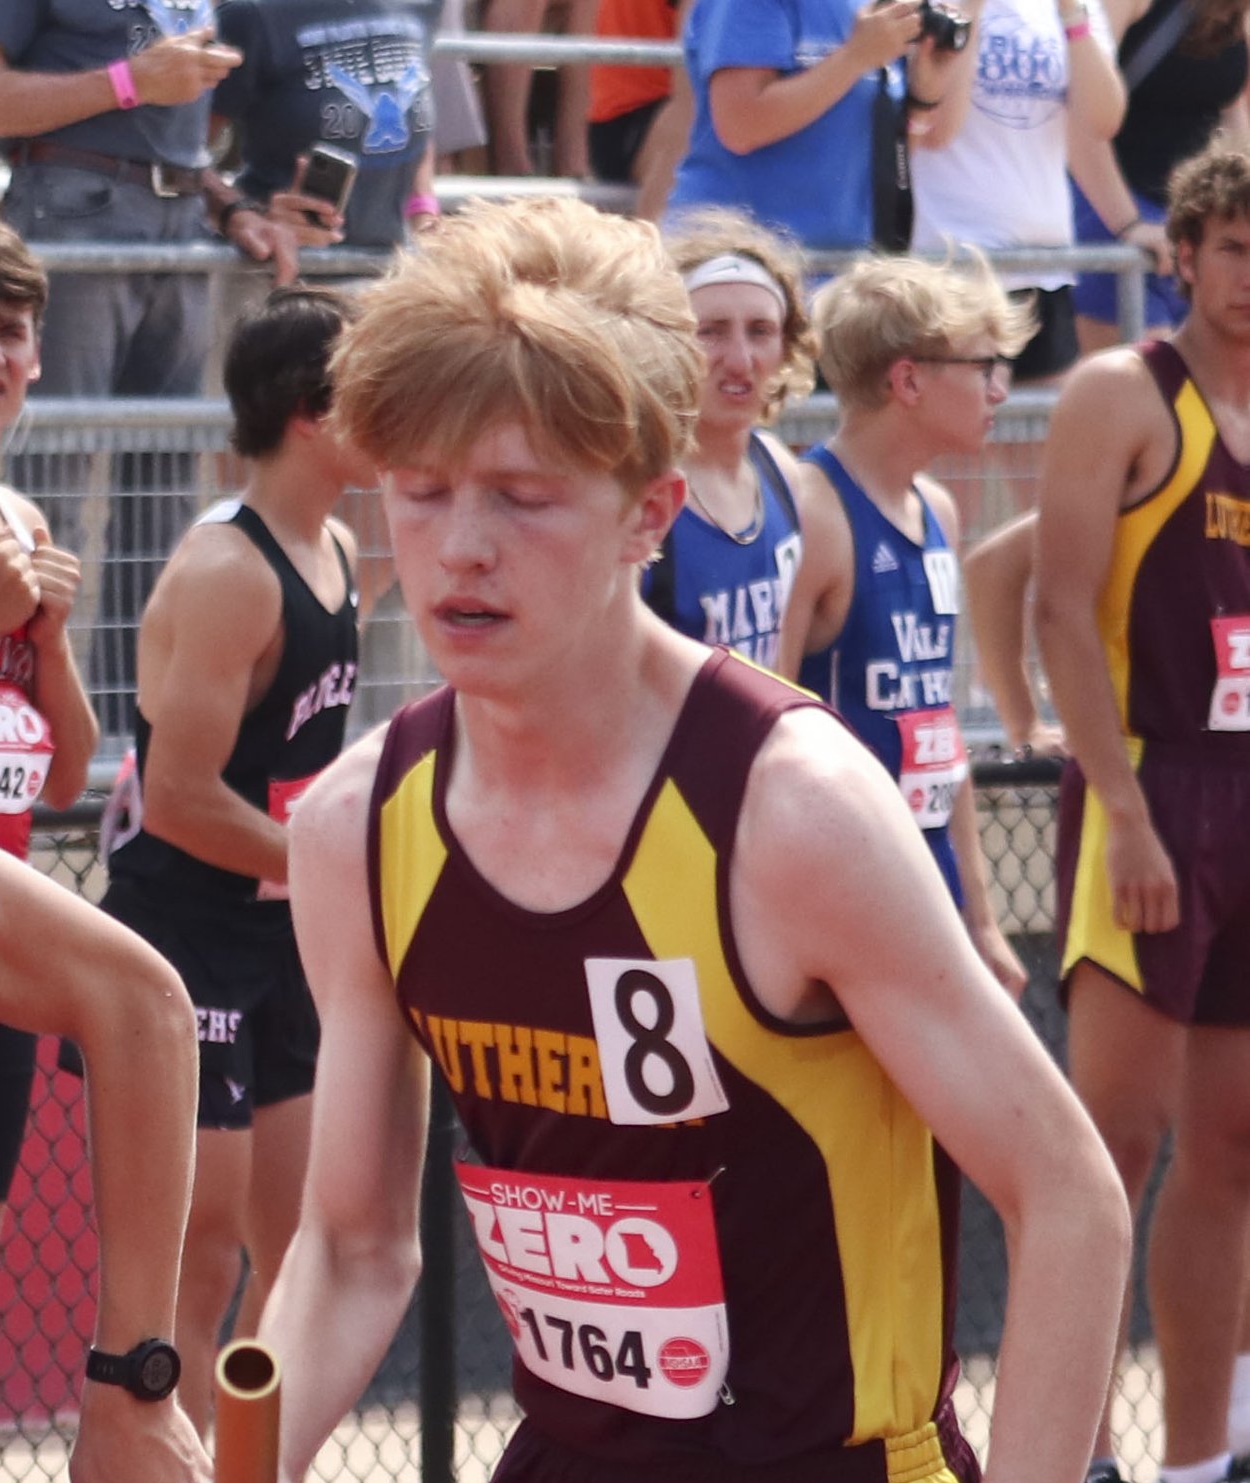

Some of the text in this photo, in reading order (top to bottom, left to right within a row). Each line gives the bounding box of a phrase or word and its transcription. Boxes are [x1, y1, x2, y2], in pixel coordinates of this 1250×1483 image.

[614, 969, 695, 1117] 8
[462, 1191, 679, 1288] ZERO
[490, 1183, 615, 1217] SHOW-ME
[520, 1306, 653, 1390] 1764
